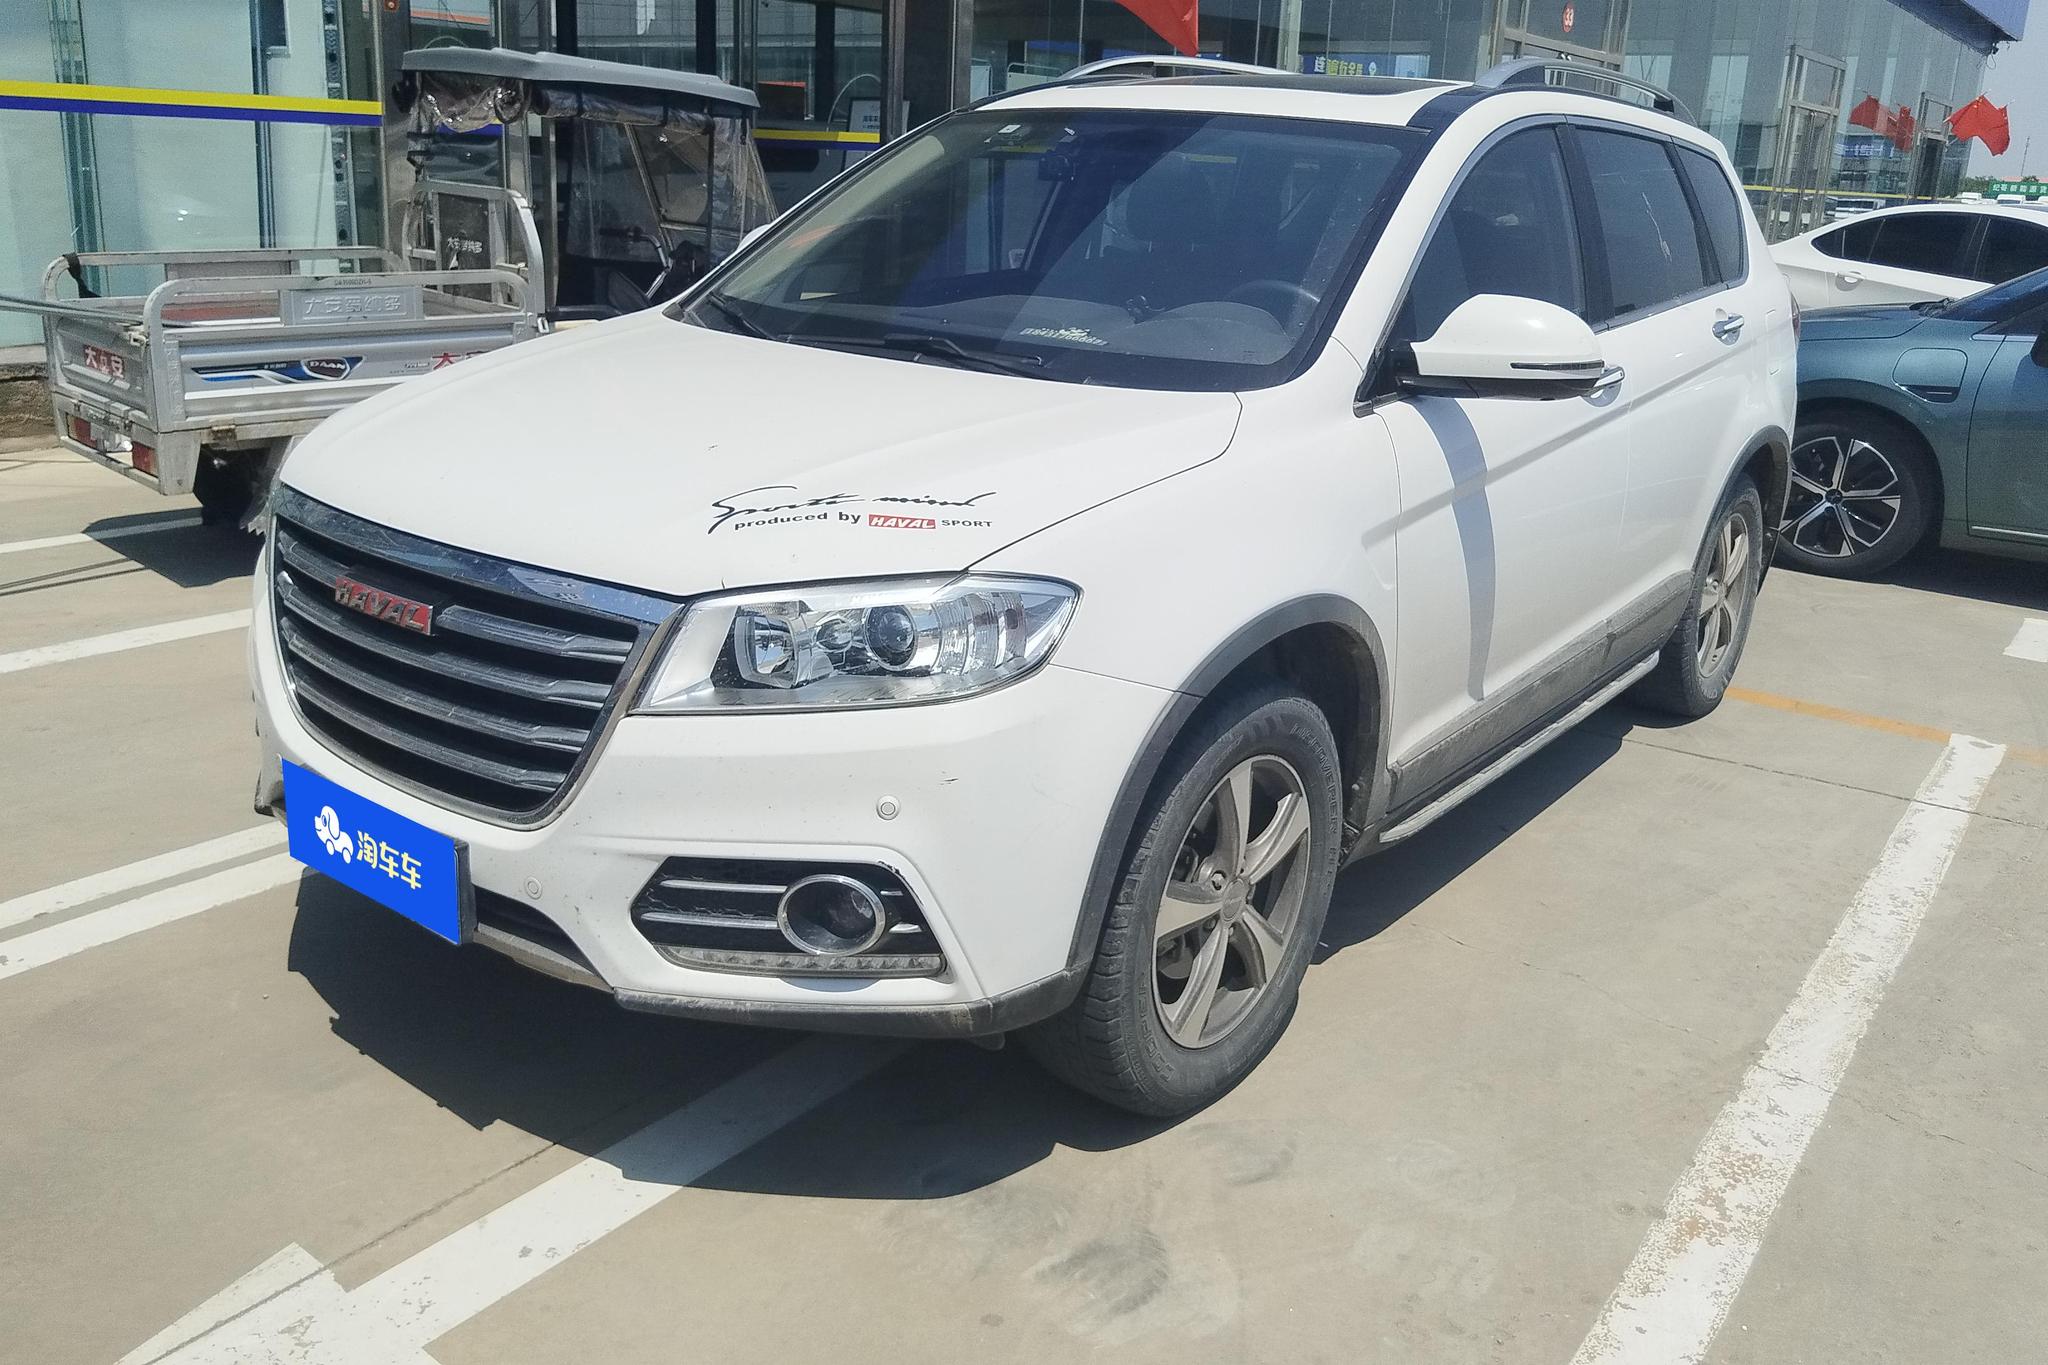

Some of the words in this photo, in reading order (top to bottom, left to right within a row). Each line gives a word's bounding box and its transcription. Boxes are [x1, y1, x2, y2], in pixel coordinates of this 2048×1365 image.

[734, 512, 828, 531] produced
[838, 511, 861, 525] by
[869, 515, 936, 529] HAVAL
[941, 519, 993, 528] SPORT
[336, 578, 426, 631] HAVAL
